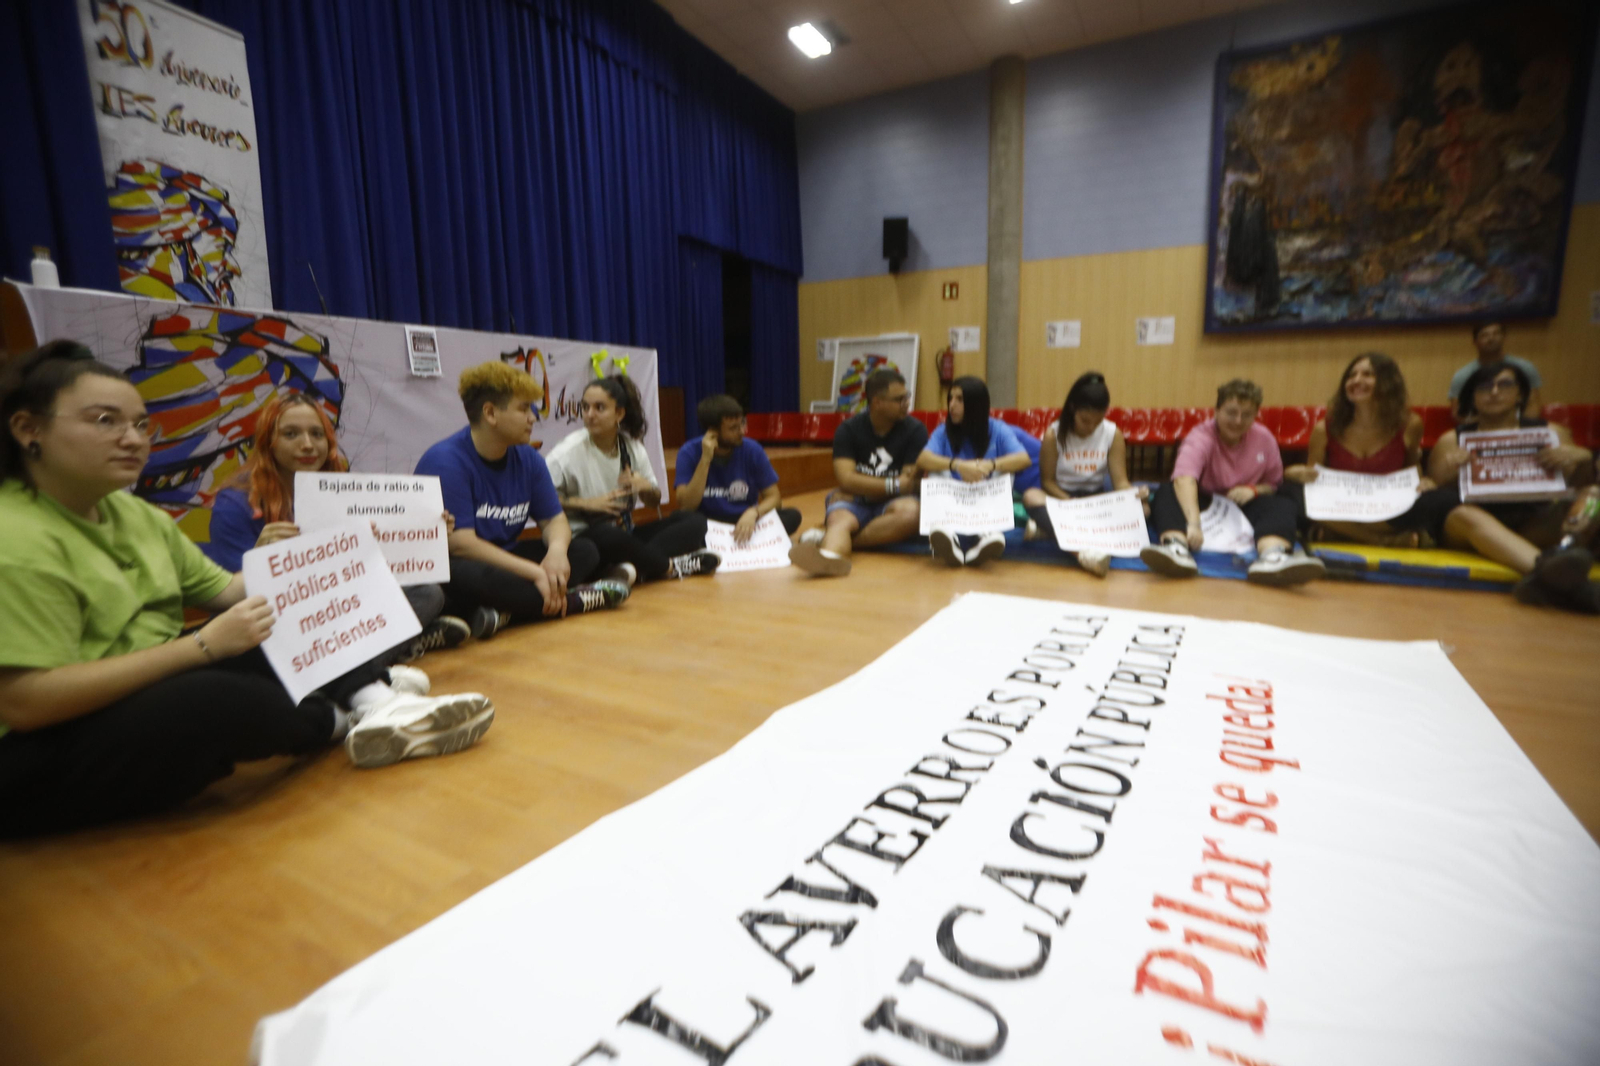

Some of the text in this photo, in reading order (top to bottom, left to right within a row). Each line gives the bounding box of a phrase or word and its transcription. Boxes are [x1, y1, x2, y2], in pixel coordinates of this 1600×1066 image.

[319, 480, 424, 494] Bajada de ratio de
[347, 503, 406, 516] alumnado
[268, 532, 360, 578] Educación
[274, 558, 366, 616] pública sin
[299, 593, 361, 634] medios
[291, 612, 387, 674] suficientes
[738, 688, 1047, 986] AVERROES
[1005, 639, 1092, 690] POR
[1050, 614, 1108, 640] LA
[1209, 780, 1280, 835] se
[850, 624, 1186, 1066] UCACIÓN PÚBLICA
